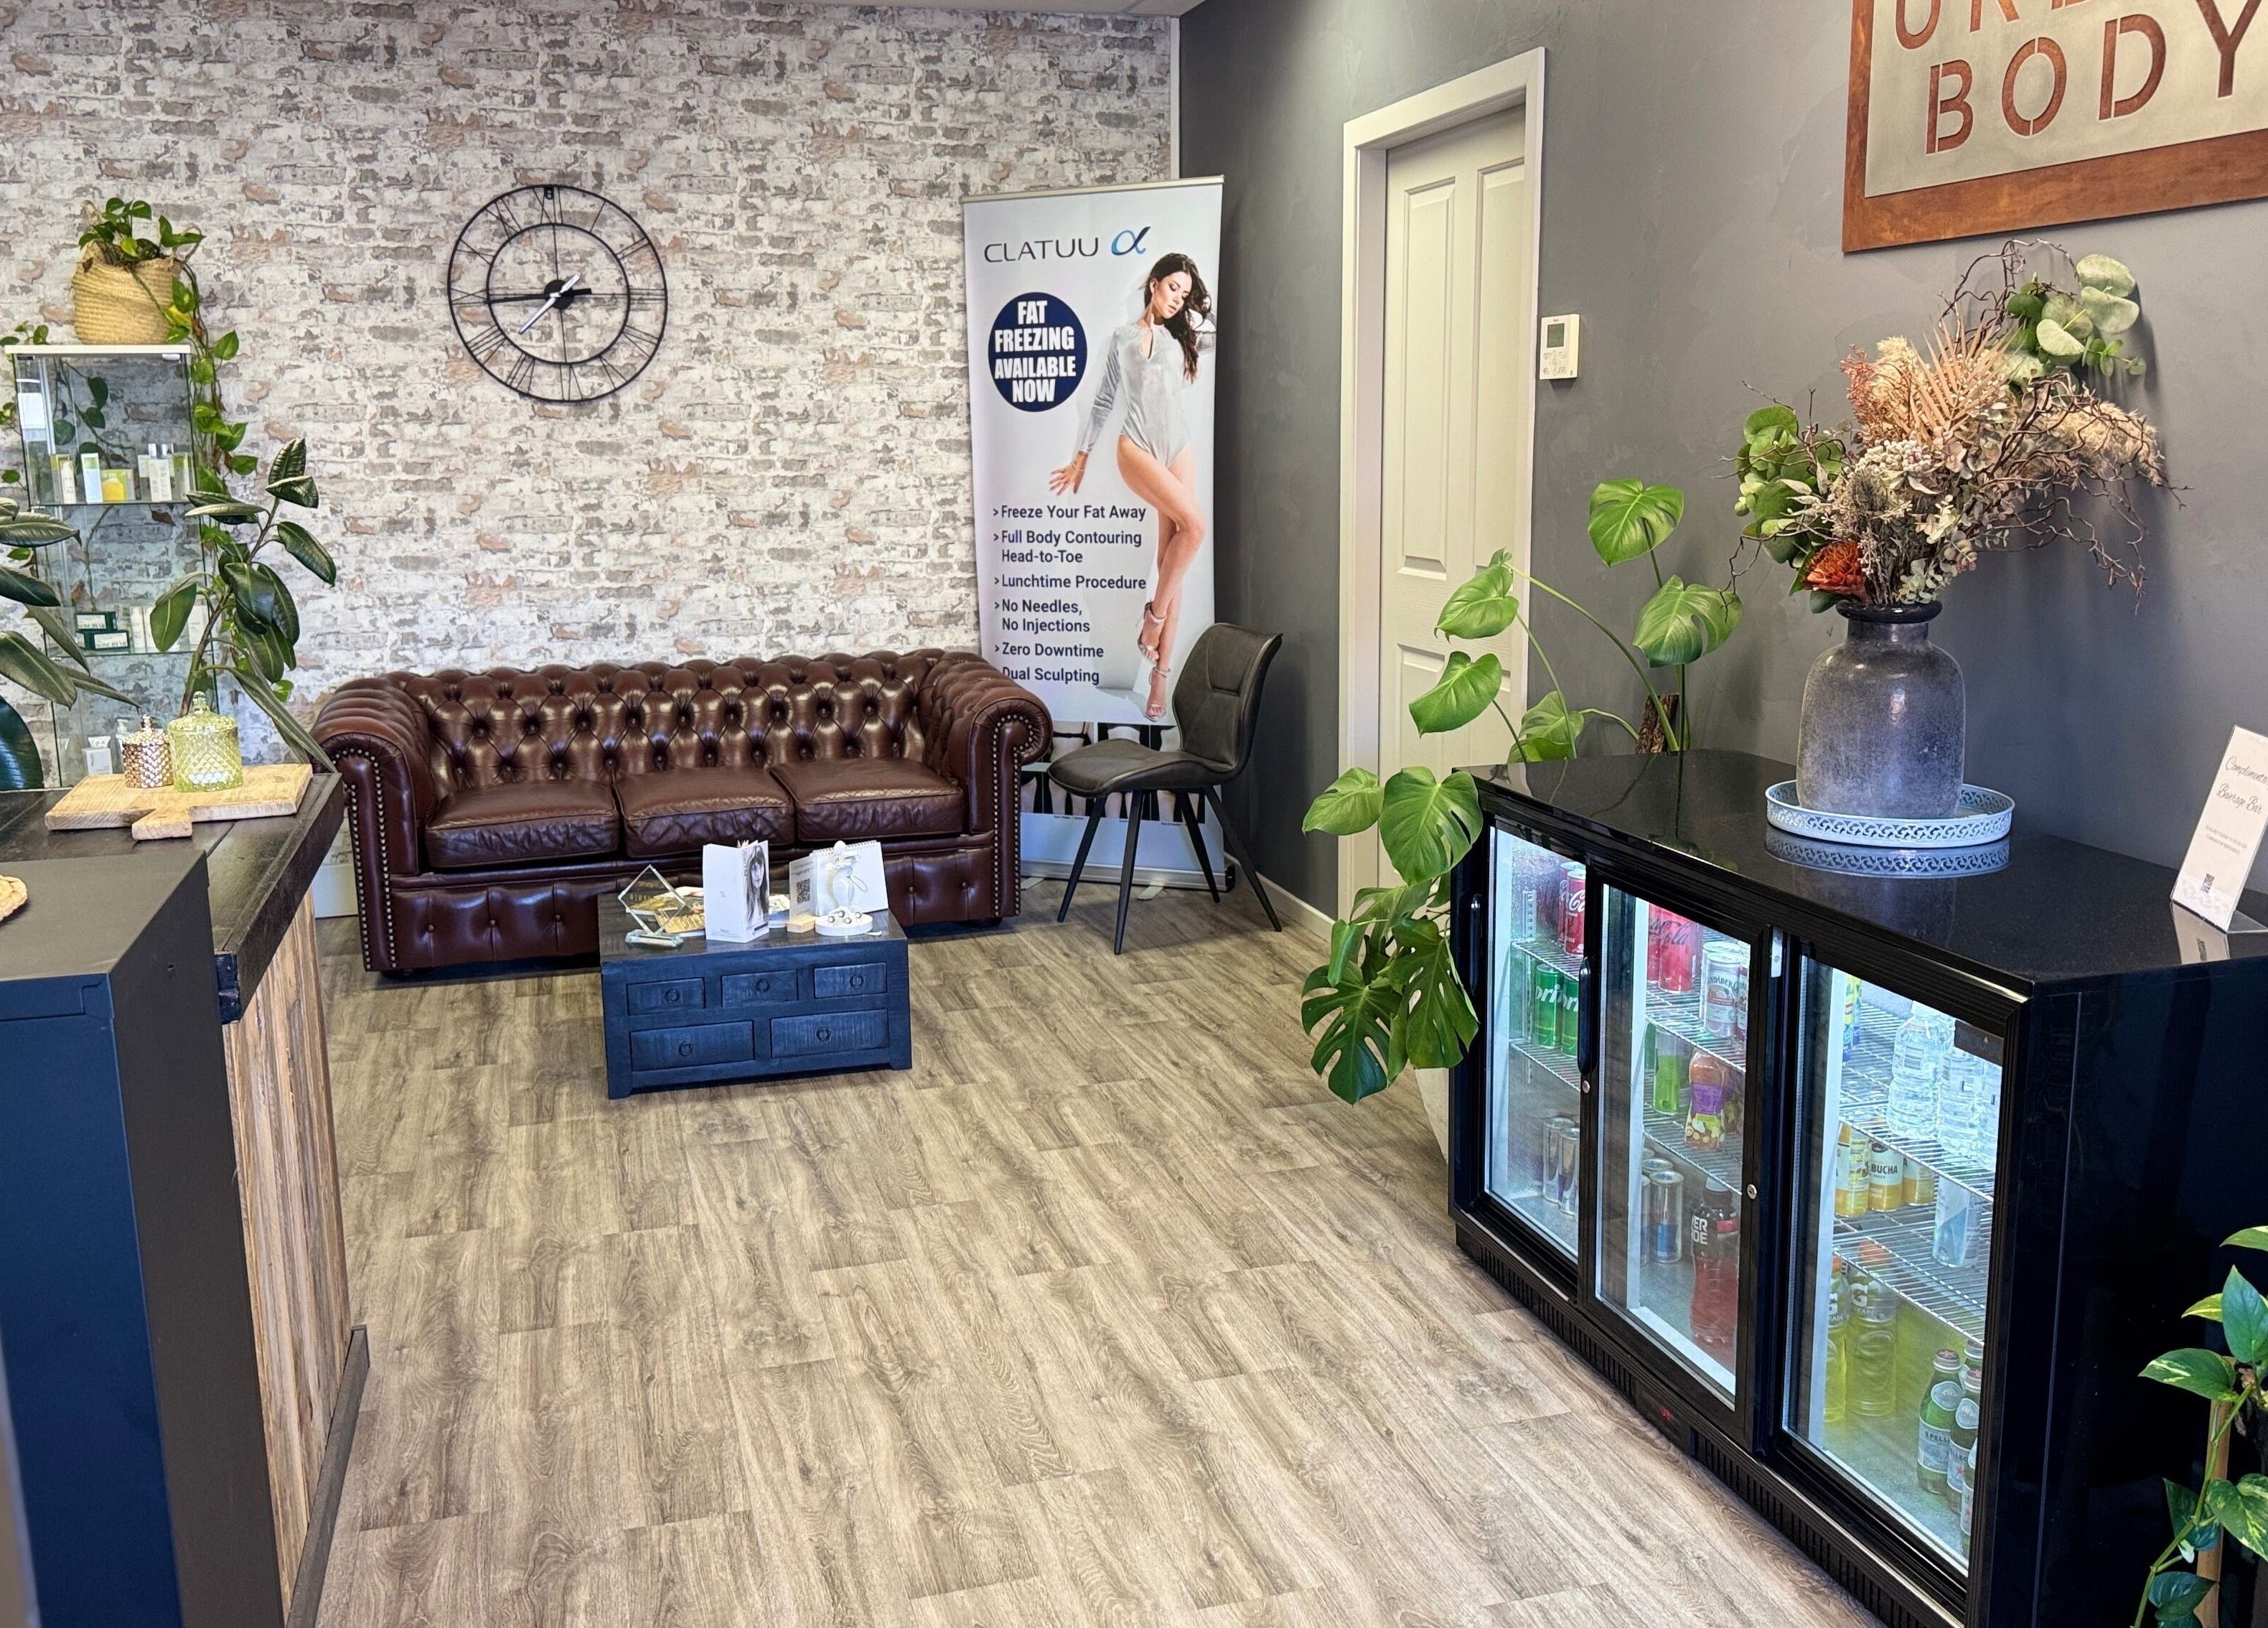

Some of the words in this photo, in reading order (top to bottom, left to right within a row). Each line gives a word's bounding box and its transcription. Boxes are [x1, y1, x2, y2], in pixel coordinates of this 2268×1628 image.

[1925, 0, 2264, 155] BODY
[983, 237, 1100, 263] CLATUU
[1016, 300, 1048, 326] FAT
[993, 326, 1076, 353] FREEZING
[993, 355, 1077, 380] AVAILABLE
[1011, 378, 1056, 403] NOW
[1001, 505, 1043, 518] Freeze
[1046, 505, 1079, 518] Your
[1084, 505, 1105, 518] Fat
[1109, 505, 1146, 522] Away
[1001, 530, 1022, 543] Full
[1026, 530, 1061, 547] Body
[1065, 531, 1142, 547] Contouring
[1002, 549, 1083, 563] Head-to-Toe
[1002, 574, 1071, 589] Lunchtime
[1076, 575, 1147, 589] Procedure
[1002, 599, 1018, 612] No
[1022, 599, 1082, 616] Needles,
[1002, 617, 1018, 631] No
[1023, 618, 1090, 634] Injections
[1002, 642, 1031, 655] Zero
[1034, 643, 1104, 658] Downtime
[1002, 666, 1030, 680] Dual
[1034, 668, 1100, 685] Sculpting
[1870, 1164, 1898, 1175] BUCHA
